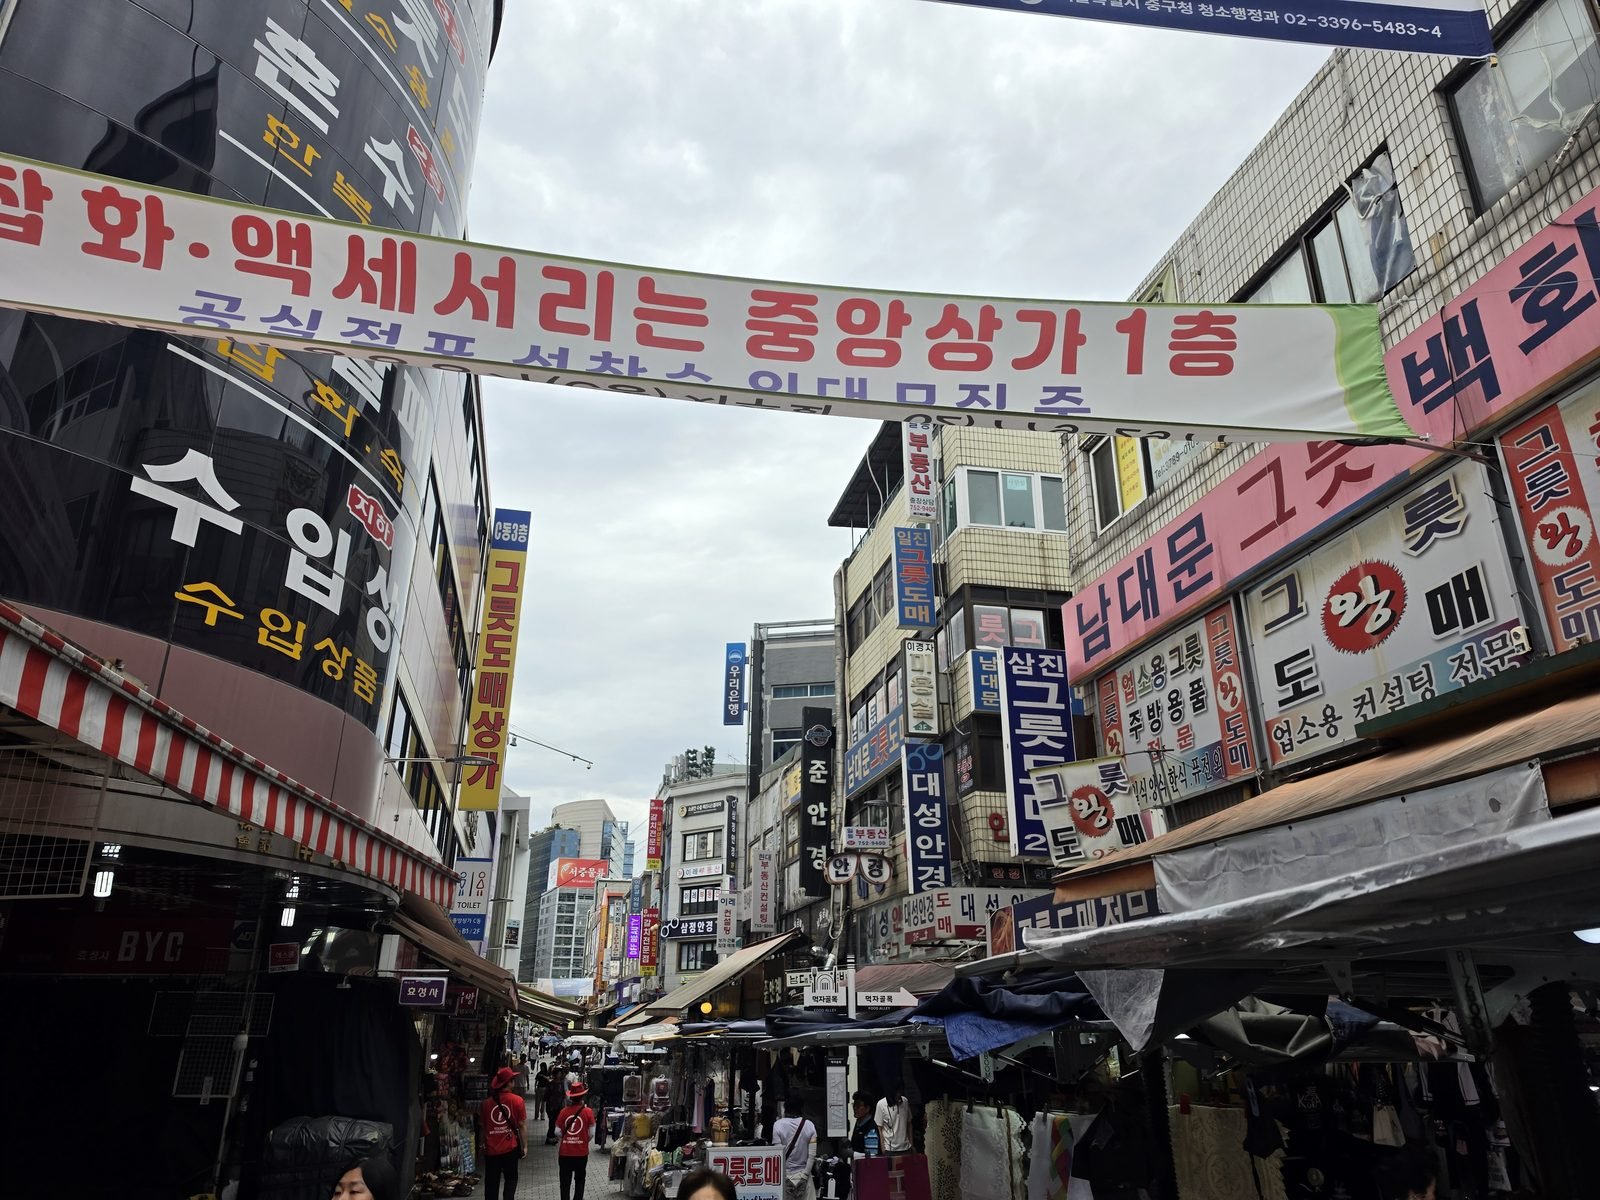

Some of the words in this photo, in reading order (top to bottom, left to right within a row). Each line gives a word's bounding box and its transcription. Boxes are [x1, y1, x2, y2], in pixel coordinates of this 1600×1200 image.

[1198, 3, 1280, 24] 청소행정과
[1283, 12, 1442, 38] 02-3396-5483~4
[745, 288, 1087, 376] 중앙상가
[1114, 308, 1238, 377] 1층
[908, 431, 932, 495] 부동산
[1514, 422, 1571, 513] 그릇
[910, 504, 936, 513] 752-9400
[494, 521, 529, 544] C동3층
[897, 530, 928, 548] 일진
[899, 548, 931, 624] 그릇도매
[1076, 512, 1215, 663] 남대문
[174, 581, 379, 705] 수입상품
[907, 639, 935, 652] 이경자
[466, 560, 521, 790] 그릇도매상가
[1007, 652, 1065, 678] 삼진
[728, 664, 740, 716] 우리은행
[1210, 613, 1234, 671] 그릇
[1224, 713, 1252, 771] 도매
[1128, 676, 1208, 742] 주방용품
[1272, 704, 1343, 755] 업소용
[806, 758, 828, 871] 준안경
[855, 828, 888, 839] 부동산
[911, 772, 947, 891] 대성안경
[758, 854, 772, 862] 현대
[832, 857, 884, 878] 안경
[457, 901, 481, 909] TOILET
[759, 861, 769, 924] 부동산컨설팅
[680, 920, 713, 934] 삼정안경
[724, 909, 732, 935] 컨설팅
[904, 893, 935, 926] 대성안경
[935, 892, 952, 933] 도매
[117, 931, 184, 962] BYC
[402, 986, 439, 999] 효성사
[812, 995, 838, 1003] 먹자골목
[864, 995, 893, 1003] 먹자골목
[713, 1155, 782, 1185] 그릇도매
